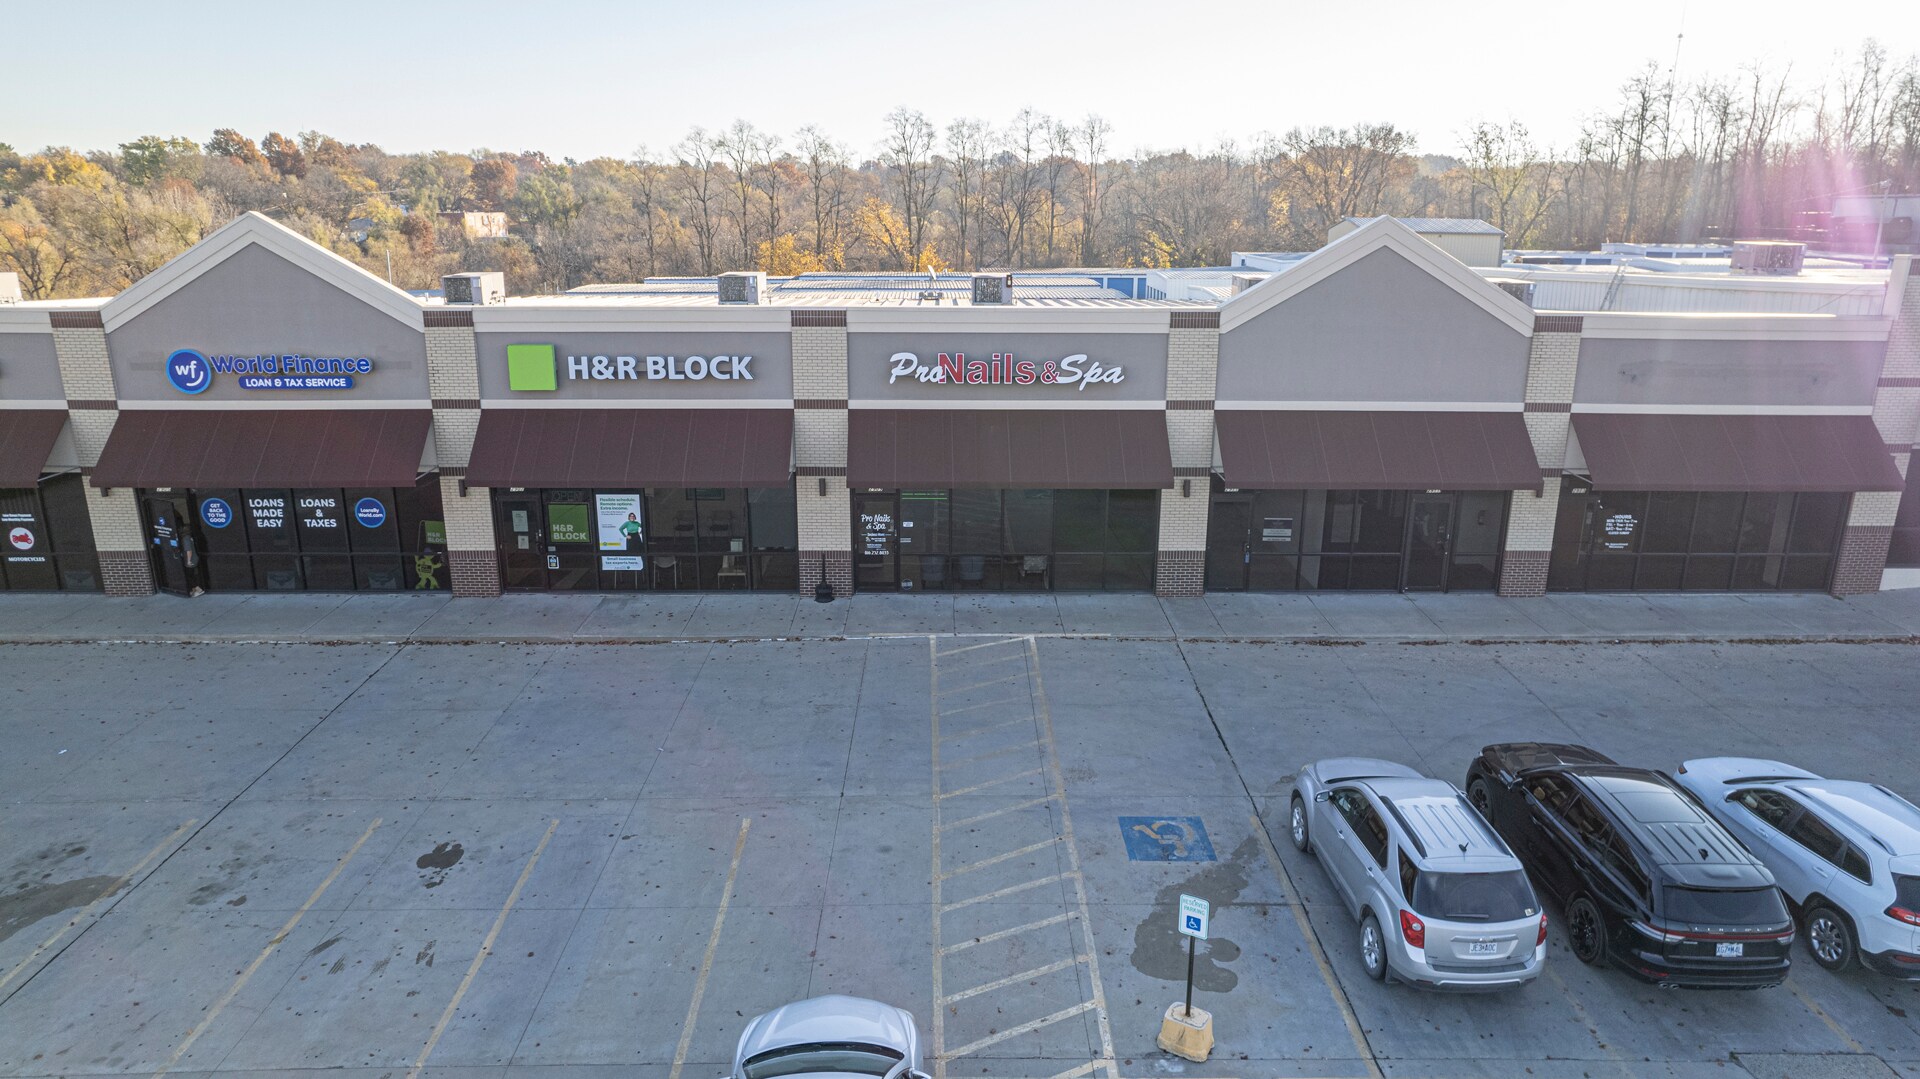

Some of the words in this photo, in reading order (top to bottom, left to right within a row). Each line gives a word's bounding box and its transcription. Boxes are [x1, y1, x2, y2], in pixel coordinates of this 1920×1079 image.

[209, 353, 281, 374] World
[281, 353, 373, 374] Finance
[567, 355, 638, 380] H&R
[646, 355, 754, 380] BLOCK
[174, 360, 198, 379] wf
[889, 352, 945, 384] Pro
[937, 352, 1037, 385] Nails
[1040, 361, 1060, 385] &
[1057, 354, 1125, 391] Spa
[245, 378, 271, 387] LOAN
[274, 378, 282, 387] &
[284, 378, 303, 387] TAX
[305, 378, 346, 387] SERVICE
[248, 498, 284, 508] LOANS
[300, 498, 336, 508] LOANS
[253, 509, 284, 518] MADE
[315, 508, 323, 518] &
[256, 519, 283, 528] EASY
[304, 519, 337, 528] TAXES
[861, 514, 873, 523] Pro
[873, 514, 891, 523] Nails
[552, 524, 574, 532] H&R
[872, 522, 886, 531] Spa
[553, 532, 586, 540] BLOCK
[1183, 898, 1208, 910] RESERVED
[1183, 904, 1206, 916] PARKING
